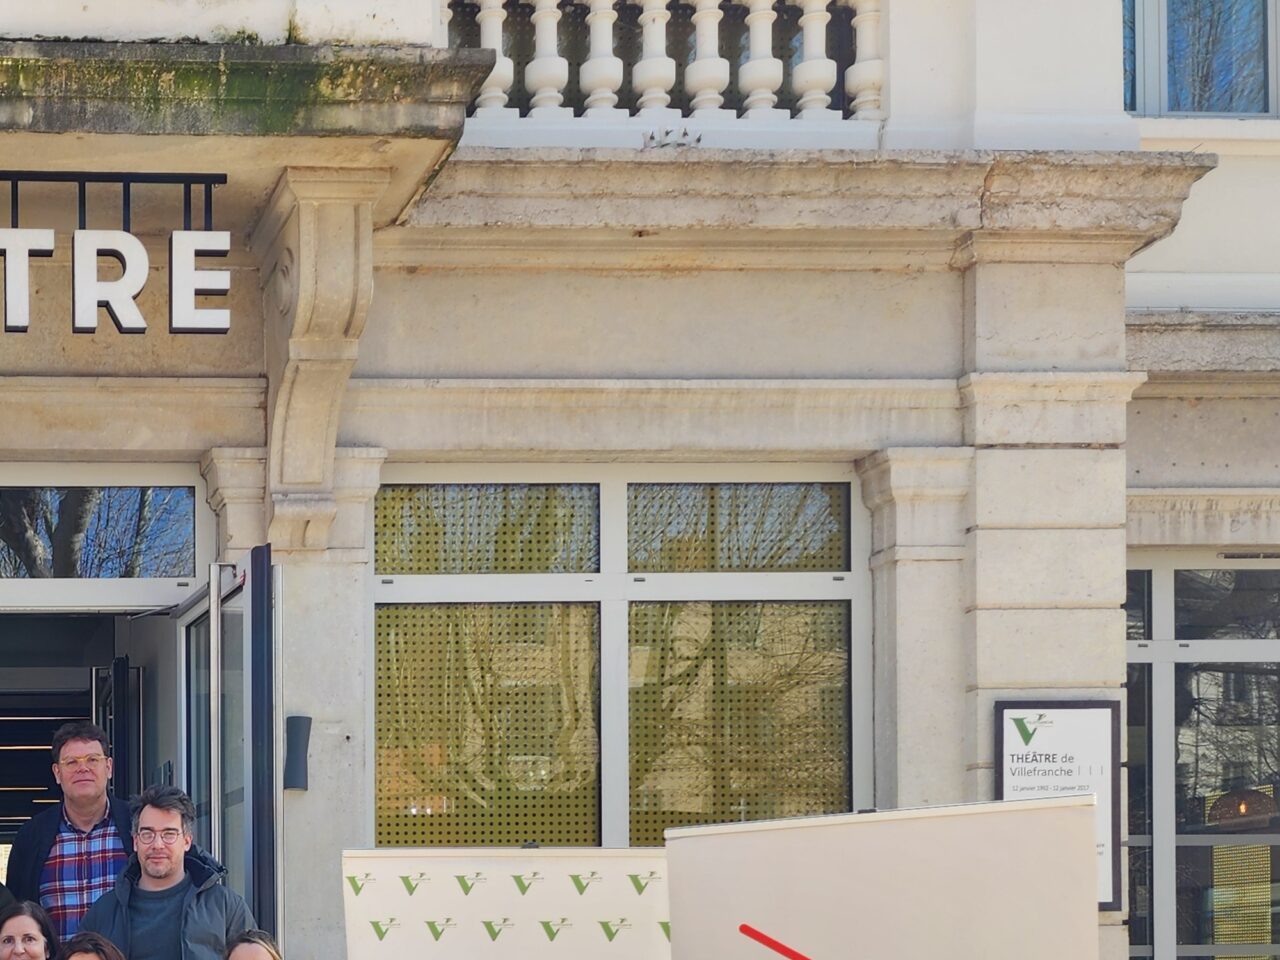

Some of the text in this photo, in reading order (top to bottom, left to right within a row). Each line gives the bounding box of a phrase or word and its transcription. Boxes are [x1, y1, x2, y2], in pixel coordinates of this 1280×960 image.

[1010, 751, 1074, 763] THÉÂTRE de
[1010, 767, 1072, 776] Villefranche
